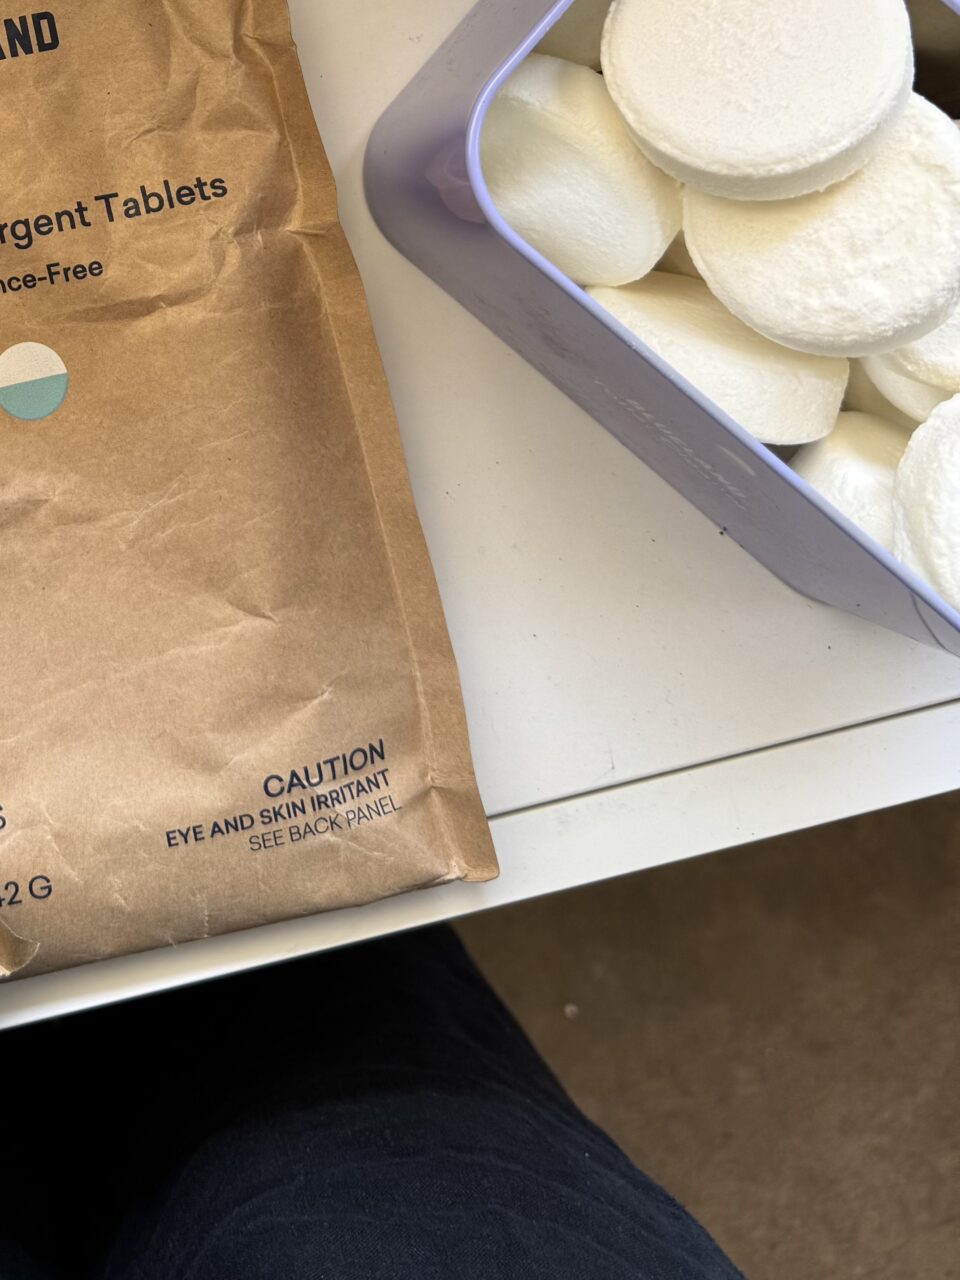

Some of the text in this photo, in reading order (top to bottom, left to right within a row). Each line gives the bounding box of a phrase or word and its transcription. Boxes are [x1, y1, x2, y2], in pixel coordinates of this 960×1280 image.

[95, 176, 228, 223] Tablets
[263, 738, 385, 798] CAUTION
[166, 768, 389, 848] EYE AND SKIN IRRITANT
[249, 795, 402, 851] SEE BACK PANEL
[29, 875, 52, 899] G
